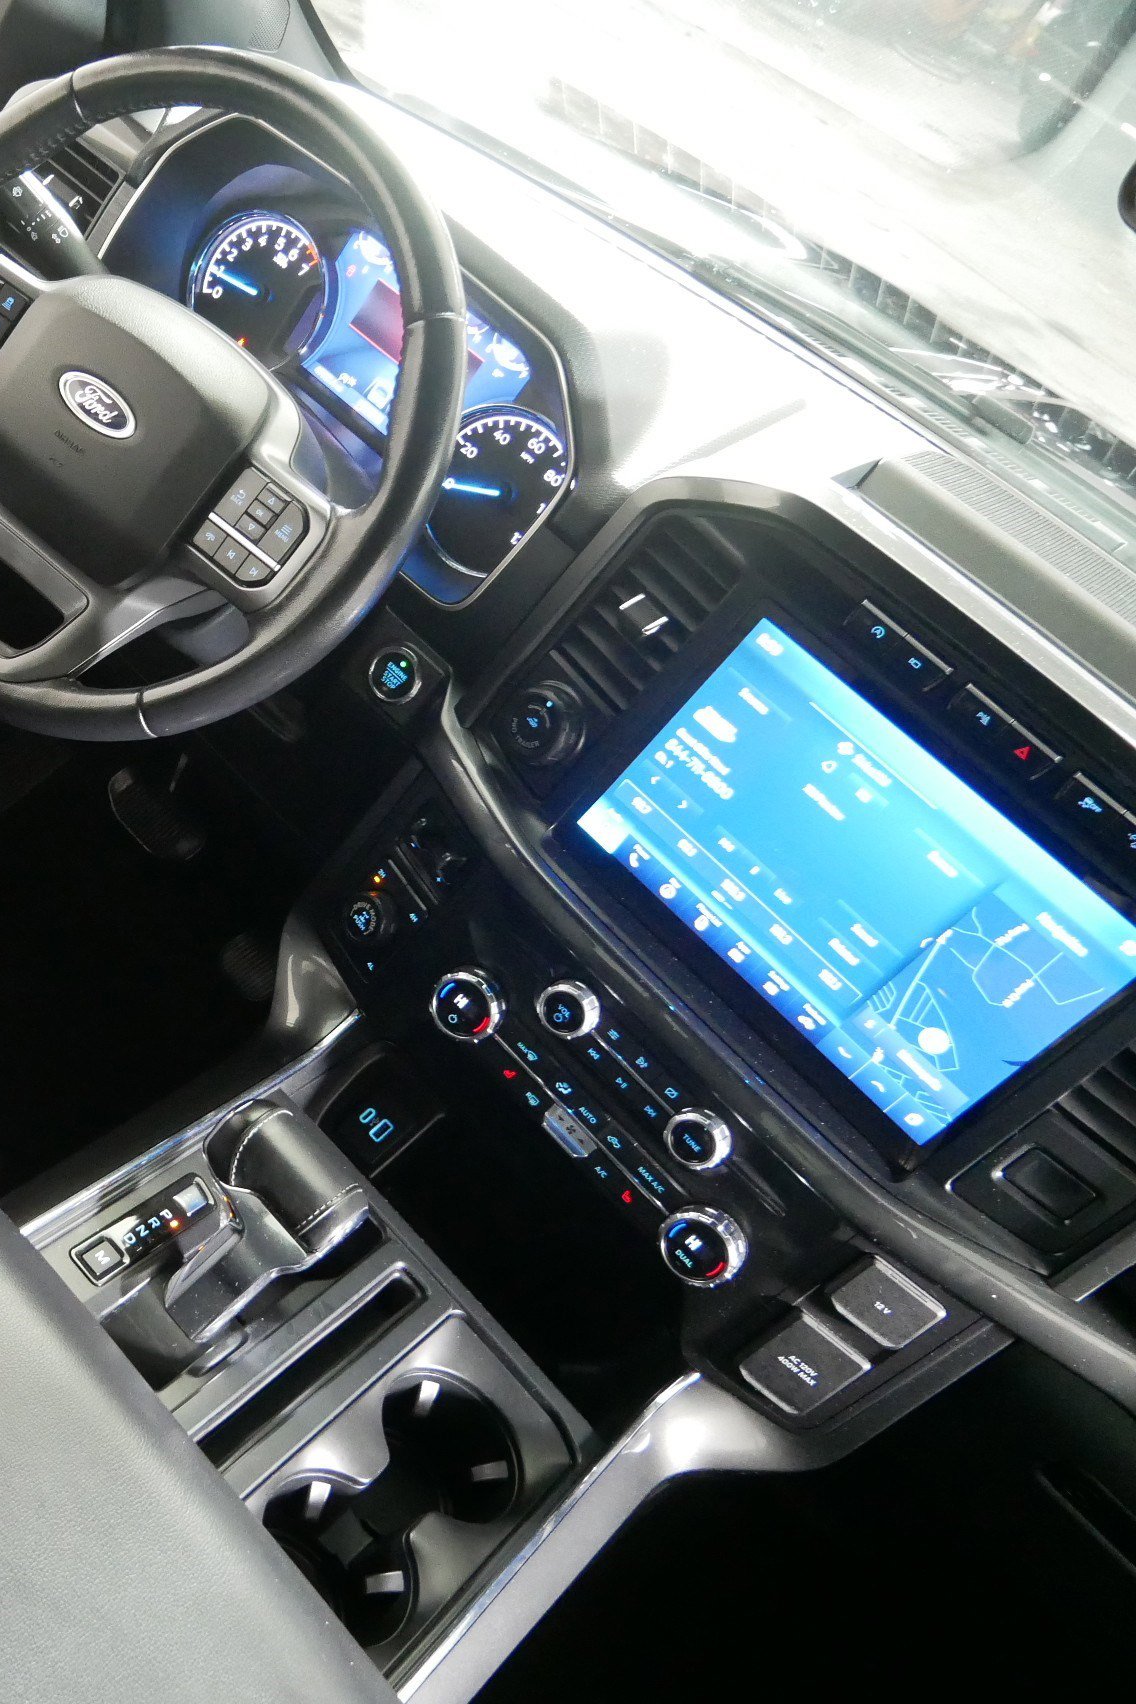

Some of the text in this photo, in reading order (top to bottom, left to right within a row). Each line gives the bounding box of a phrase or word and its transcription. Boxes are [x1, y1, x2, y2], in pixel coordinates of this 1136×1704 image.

[242, 238, 254, 251] 3
[258, 235, 269, 248] 4
[275, 237, 287, 251] 5
[227, 249, 239, 262] 2
[288, 248, 300, 262] 6
[298, 263, 310, 276] 7
[212, 286, 223, 299] 0
[74, 385, 119, 423] Ford
[493, 430, 511, 445] 40
[460, 442, 479, 458] 20
[527, 438, 545, 454] 60
[543, 469, 562, 487] 80
[274, 529, 290, 543] MENU
[383, 670, 402, 687] START
[387, 661, 408, 682] ENGINE
[381, 675, 396, 689] STOP
[353, 914, 366, 931] PUSH
[558, 1003, 571, 1018] VOL
[578, 1106, 597, 1124] AUTO
[682, 1133, 702, 1153] TUNE
[594, 1166, 608, 1179] A/C
[637, 1166, 665, 1194] MAX A/C
[159, 1208, 173, 1220] P
[148, 1216, 161, 1229] R
[123, 1232, 136, 1244] D
[135, 1224, 149, 1238] N
[94, 1249, 111, 1265] M
[674, 1249, 693, 1268] DUAL
[874, 1301, 885, 1311] 12
[777, 1356, 817, 1387] 400W MAX
[787, 1355, 818, 1377] AC 120V
